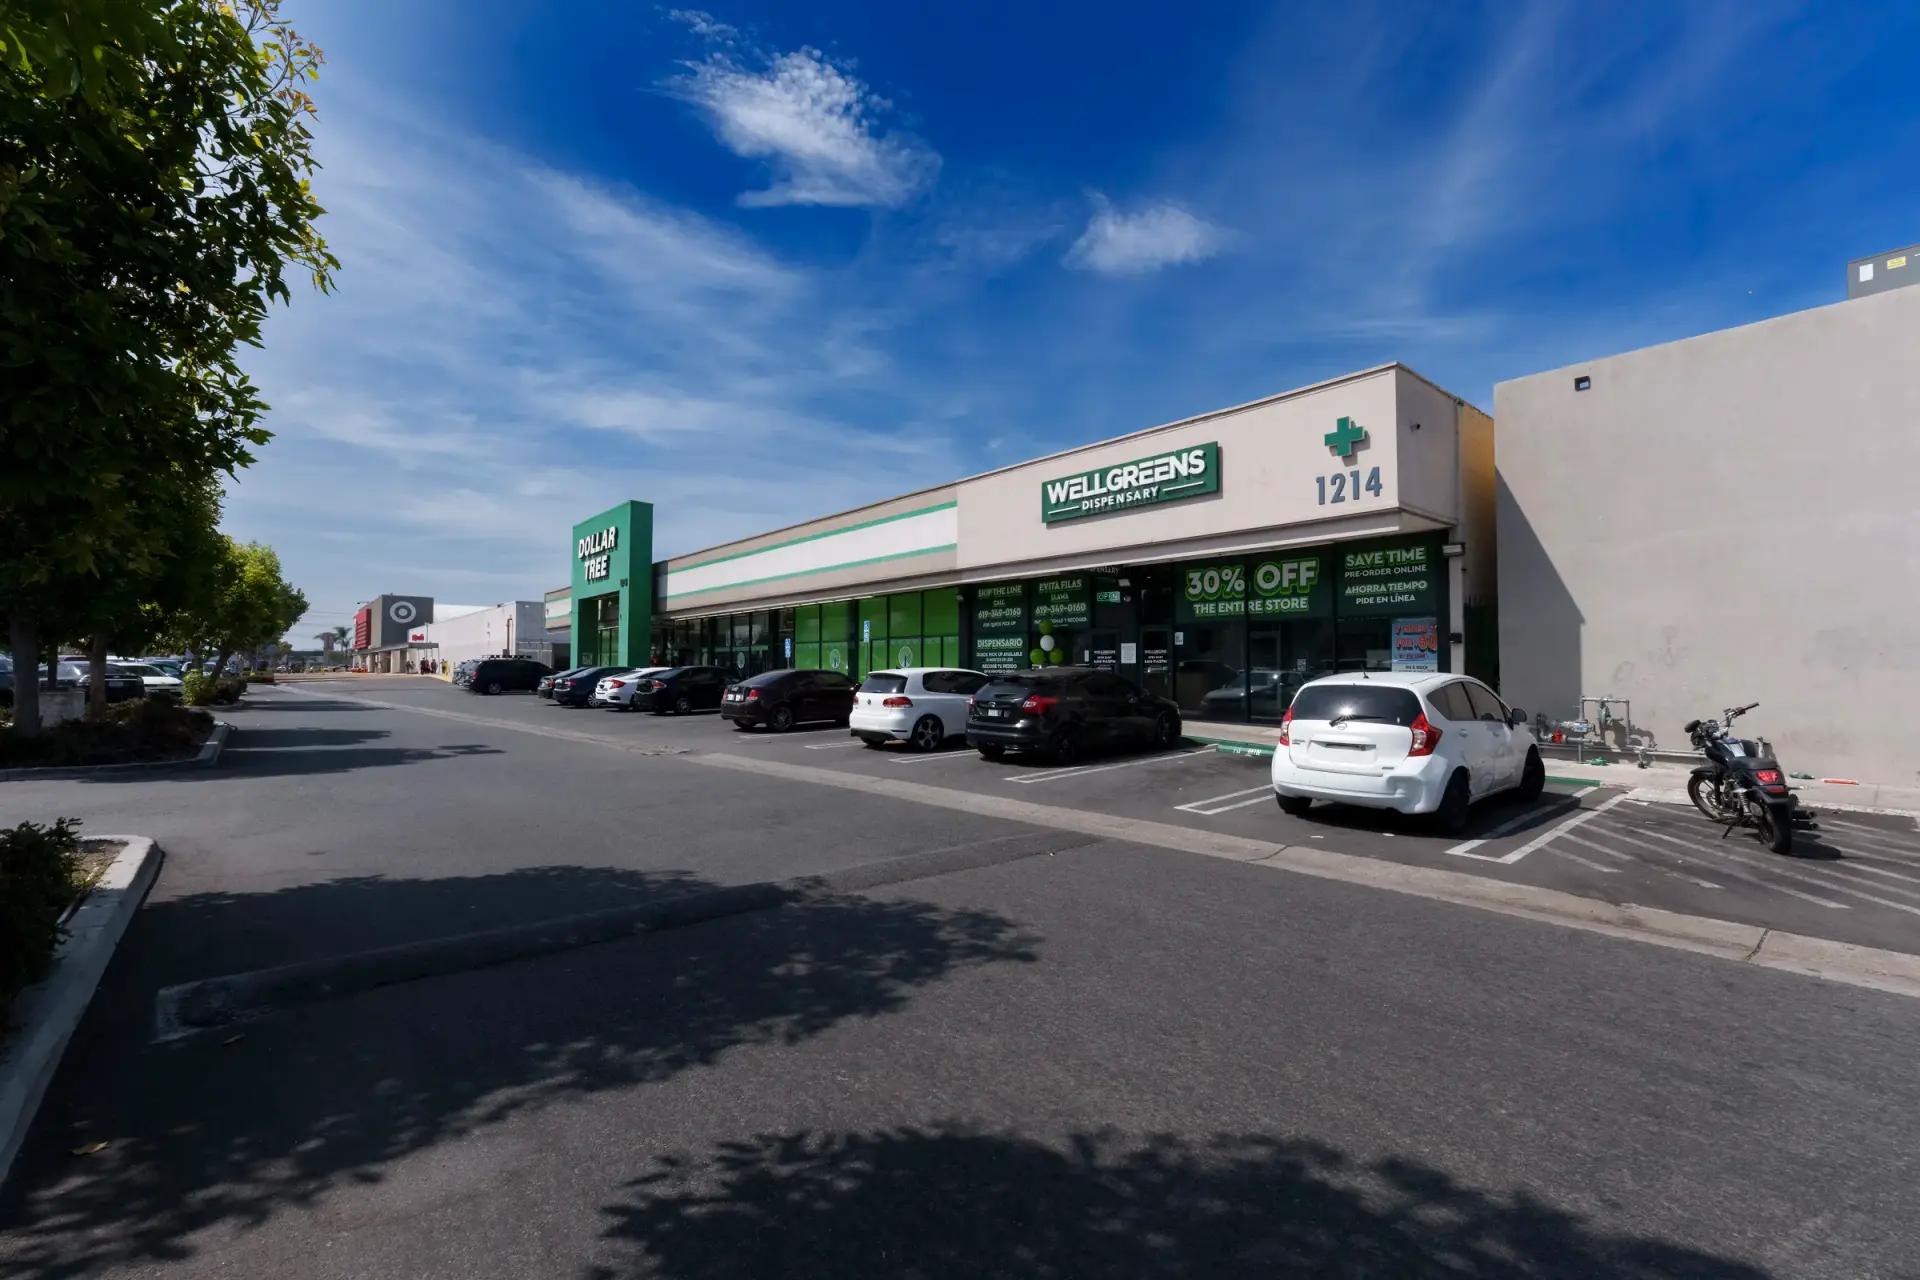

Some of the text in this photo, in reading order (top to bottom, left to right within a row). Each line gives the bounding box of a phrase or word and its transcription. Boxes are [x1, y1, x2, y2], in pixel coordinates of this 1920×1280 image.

[1047, 450, 1206, 504] WELLGREENS
[1316, 466, 1383, 505] 1214
[1082, 486, 1159, 510] DISPENSARY
[578, 526, 616, 559] DOLLAR
[1346, 547, 1425, 567] SAVE TIME
[584, 555, 608, 580] TREE
[1345, 564, 1427, 578] PRE-ORDER ONLINE
[1040, 579, 1082, 591] EVITA FILAS
[1187, 560, 1317, 595] 30% OFF
[993, 587, 1005, 596] THE
[1007, 585, 1022, 595] LINE
[1345, 581, 1428, 595] AHORRA TIEMPO
[1194, 598, 1308, 614] THE ENTIRE STORE
[1390, 593, 1416, 602] LÍNEA
[977, 638, 1023, 648] DISPENSARIO
